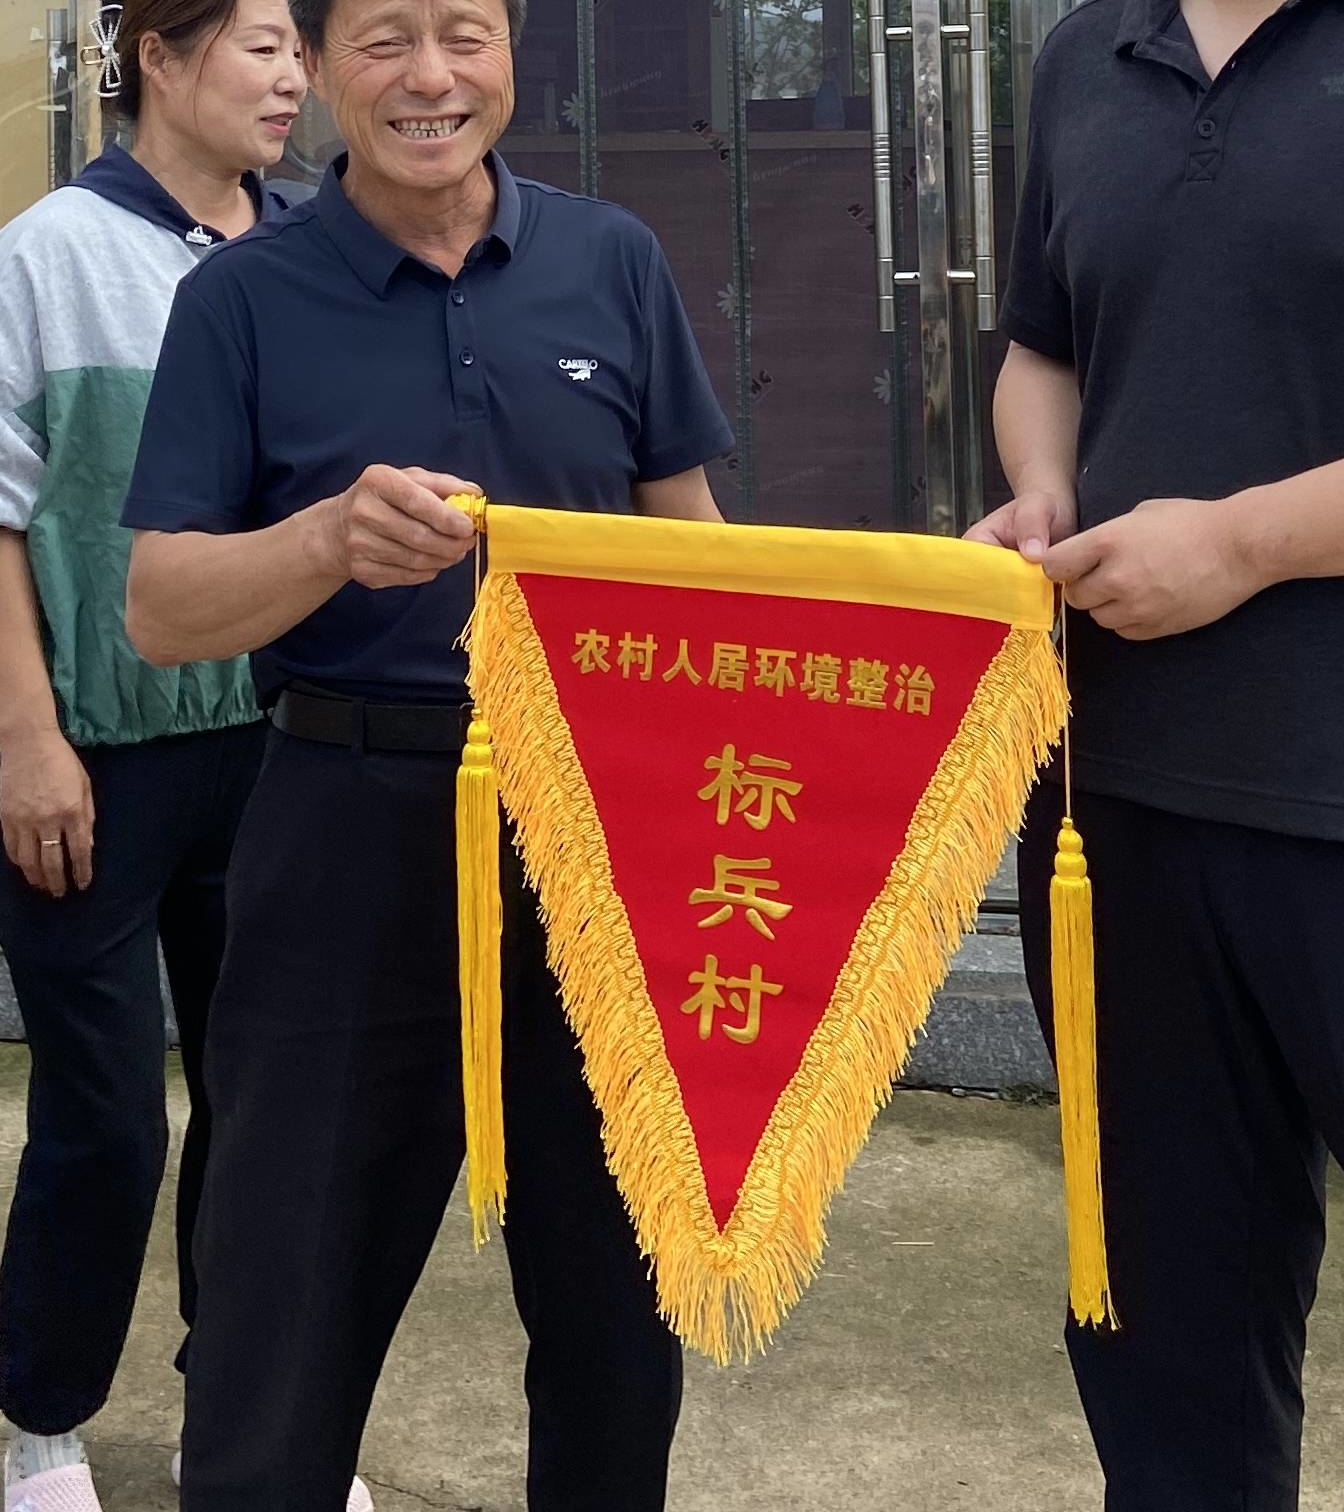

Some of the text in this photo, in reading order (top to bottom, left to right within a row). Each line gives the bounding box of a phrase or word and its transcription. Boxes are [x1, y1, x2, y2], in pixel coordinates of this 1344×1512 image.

[571, 628, 936, 716] 农村人居环境整治
[680, 743, 804, 1045] 标兵村
